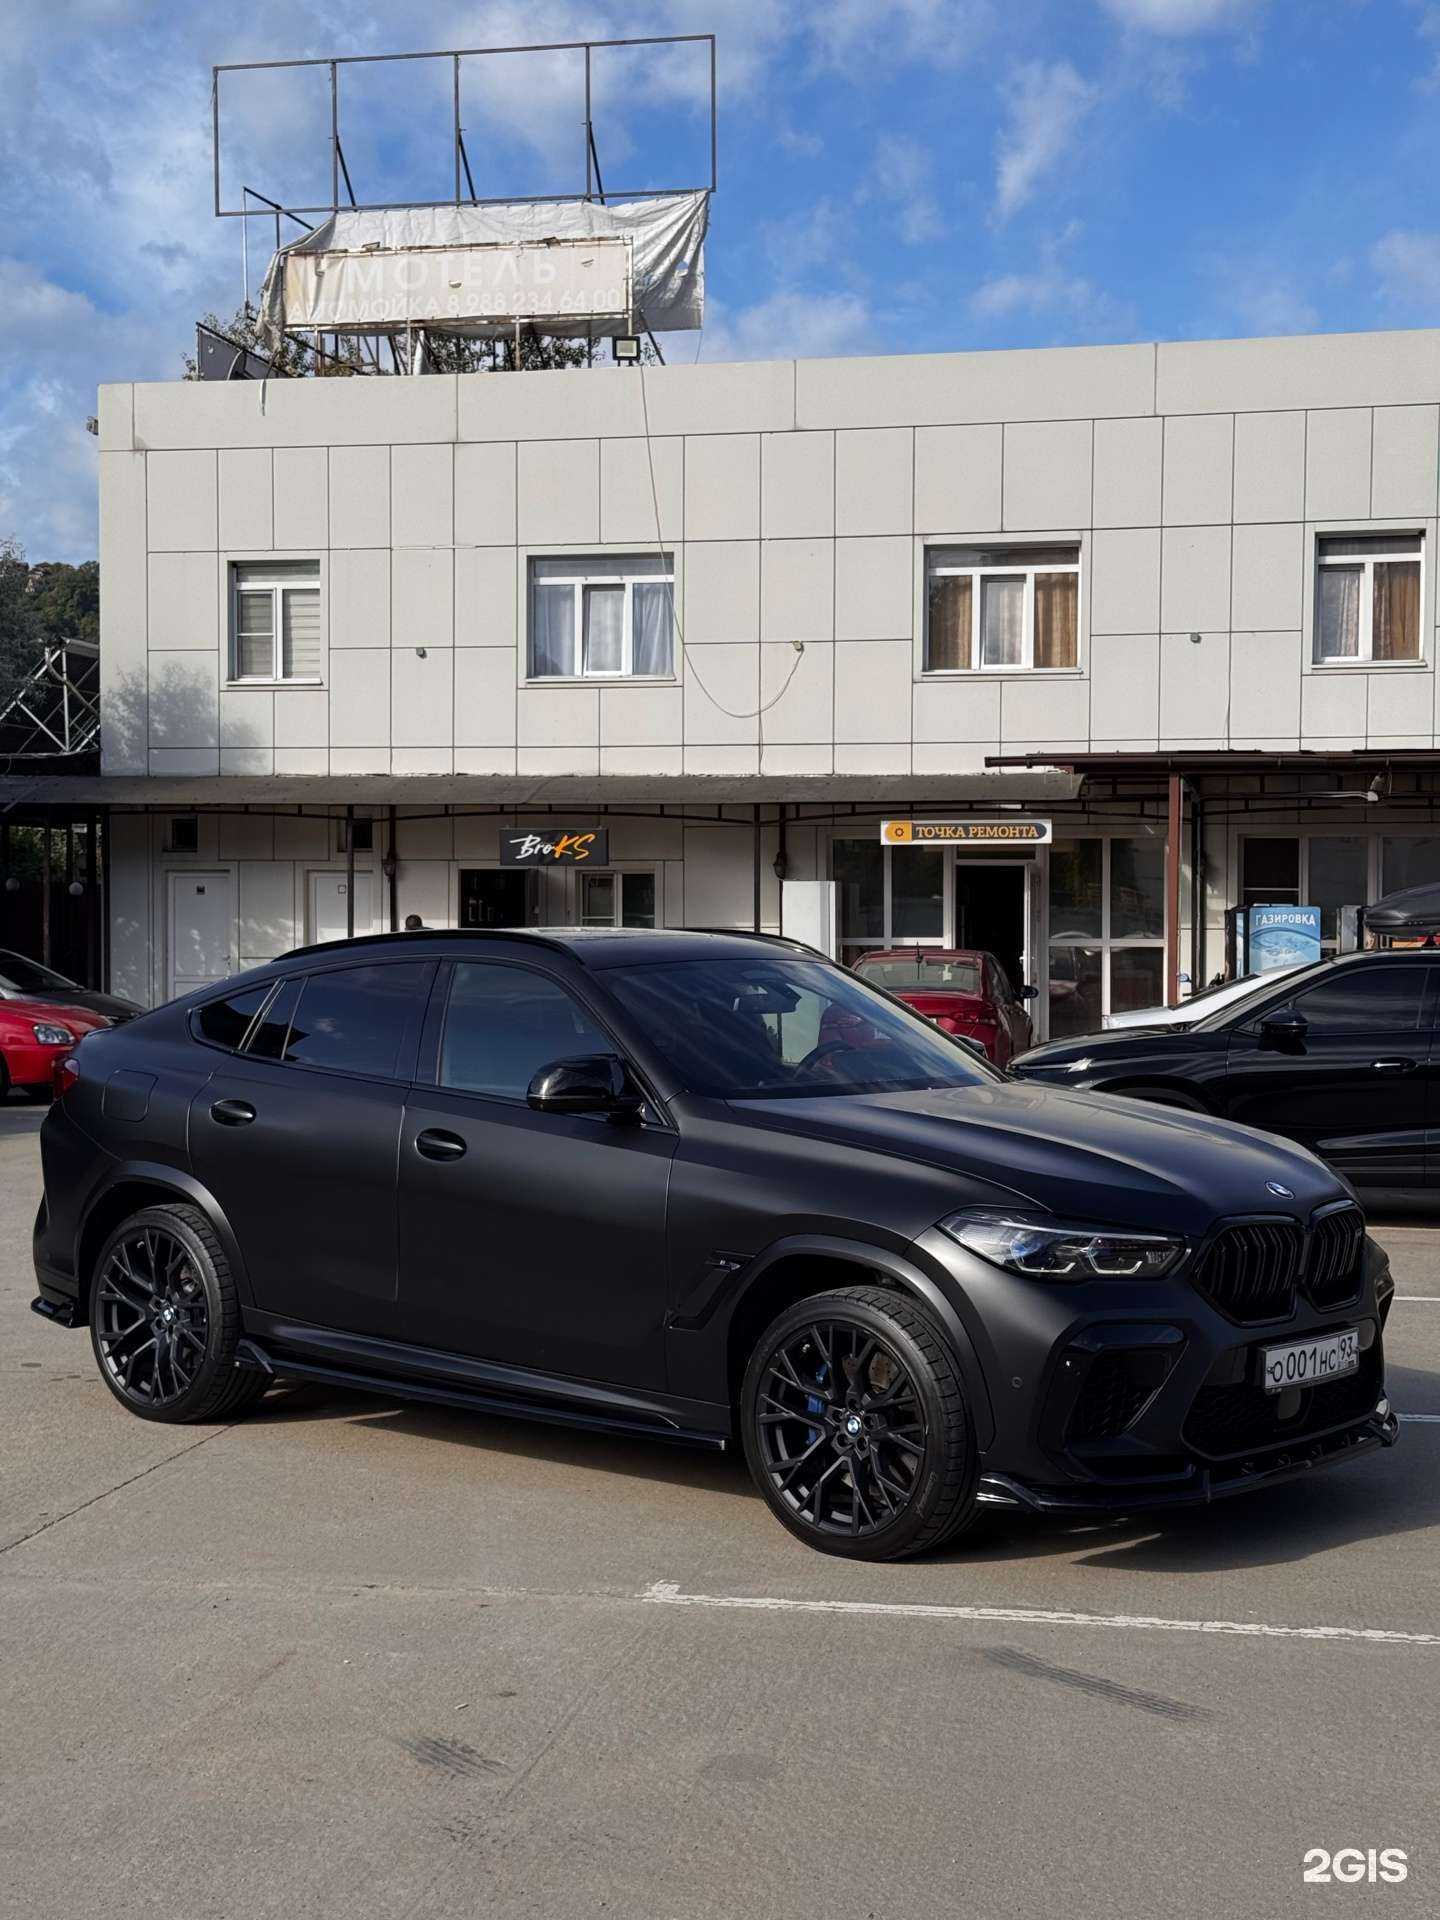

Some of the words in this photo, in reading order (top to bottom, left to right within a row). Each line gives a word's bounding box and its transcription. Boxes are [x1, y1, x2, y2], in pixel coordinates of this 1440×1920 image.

[346, 252, 556, 292] МОТЕЛЬ
[289, 294, 442, 320] АТОМОЙКА
[447, 294, 460, 313] 8
[512, 290, 553, 311] 234
[916, 826, 965, 838] ТОЧКА
[969, 826, 1039, 838] РЕМОНТА
[509, 833, 596, 860] BroKS
[1255, 913, 1316, 926] ГАЗИРОВКА
